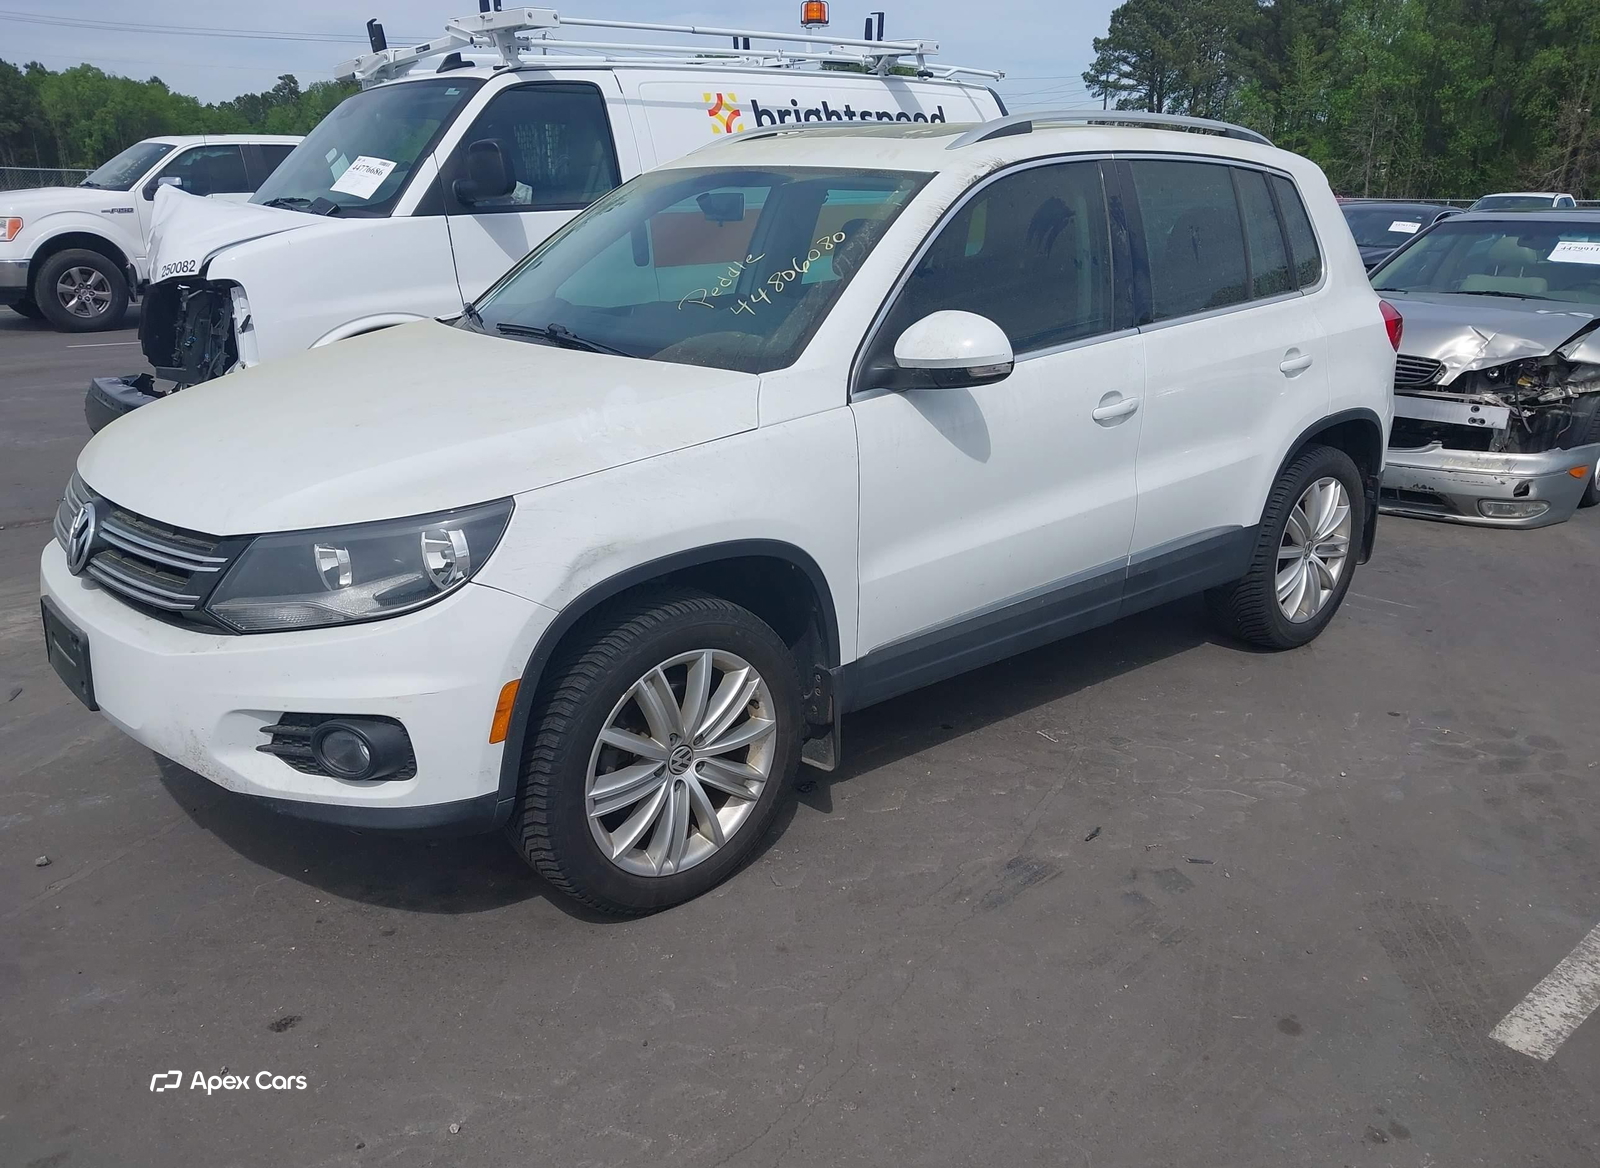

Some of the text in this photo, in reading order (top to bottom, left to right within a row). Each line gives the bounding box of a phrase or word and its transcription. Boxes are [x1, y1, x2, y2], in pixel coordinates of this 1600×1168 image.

[352, 163, 383, 176] 44776686
[161, 259, 196, 278] 250082
[730, 231, 846, 315] 44806080
